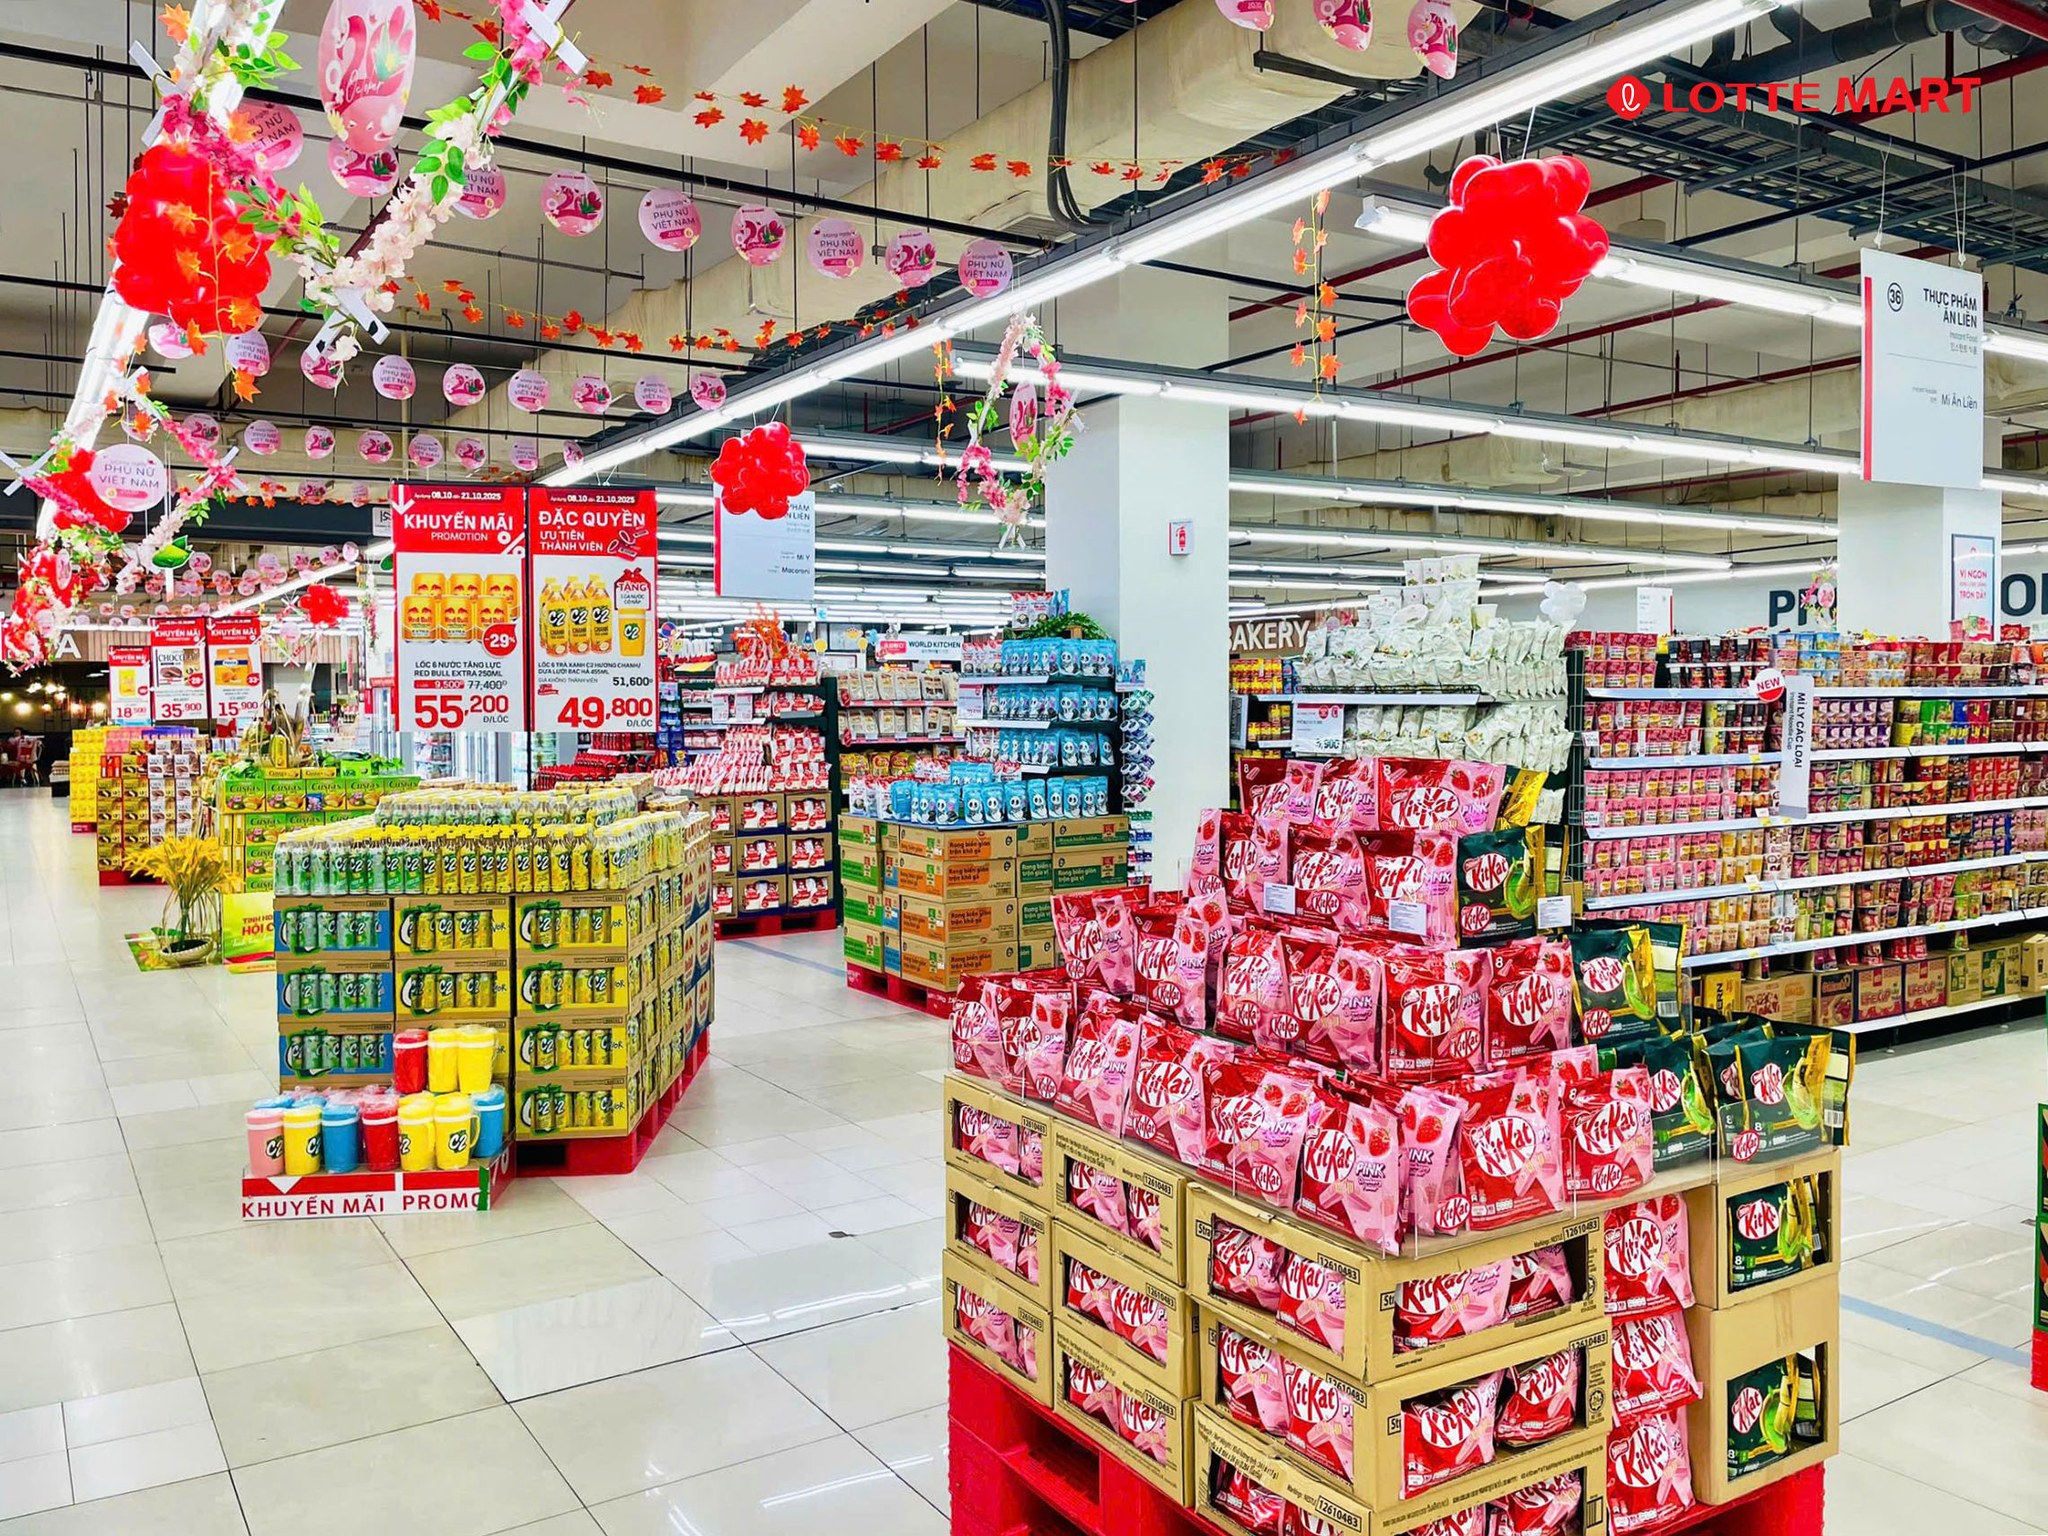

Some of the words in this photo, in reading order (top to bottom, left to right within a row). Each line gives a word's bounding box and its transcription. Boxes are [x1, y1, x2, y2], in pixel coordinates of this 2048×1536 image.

[674, 217, 695, 229] NAM
[839, 248, 859, 256] NAM
[841, 238, 855, 247] NỮ
[986, 270, 1008, 278] NAM
[991, 259, 1004, 269] NỮ
[1889, 289, 1901, 305] 36
[1923, 288, 1949, 308] THỰC
[130, 476, 159, 488] NAM
[404, 511, 476, 530] KHUYẾN
[480, 512, 513, 531] MÃI
[538, 508, 579, 529] ĐẶC
[583, 508, 646, 527] QUYỀN
[431, 532, 488, 541] PROMOTION
[540, 530, 557, 540] ƯU
[559, 529, 585, 540] TIÊN
[540, 540, 577, 551] THÀNH
[578, 540, 603, 551] VIÊN
[618, 581, 647, 593] TẶNG
[548, 610, 566, 626] C2
[571, 608, 588, 624] C2
[593, 606, 610, 623] C2
[624, 625, 640, 639] C2
[1229, 619, 1311, 651] AKERY
[933, 641, 961, 649] KITCHEN
[485, 661, 501, 669] LỰC
[1757, 677, 1781, 692] NEW
[415, 694, 509, 728] 55,200
[557, 696, 653, 729] 49,800
[627, 718, 653, 727] Đ/LỐC
[1399, 787, 1456, 826] KitKat
[443, 856, 457, 872] C2
[463, 857, 476, 872] C2
[515, 854, 530, 869] C2
[1297, 852, 1341, 889] KitKat
[1470, 854, 1508, 891] KitKat
[1314, 894, 1338, 913] KitKat
[439, 919, 453, 933] C2
[1463, 906, 1489, 931] KitKat
[1180, 957, 1204, 968] PINK
[1291, 974, 1338, 1020] KitKat
[1343, 996, 1372, 1010] PINK
[1508, 975, 1553, 1024] KitKat
[1411, 985, 1461, 1035] KitKat
[1273, 1015, 1299, 1037] KitKat
[1453, 1031, 1479, 1056] KitKat
[1141, 1062, 1191, 1106] KitKat
[1022, 1117, 1046, 1134] 12610483
[1135, 1117, 1156, 1139] KitKat
[1583, 1101, 1636, 1153] KitKat
[449, 1133, 468, 1151] C2
[1482, 1118, 1532, 1175] KitKat
[1305, 1130, 1353, 1182] KitKat
[1254, 1167, 1280, 1191] KitKat
[1356, 1161, 1386, 1179] PINK
[1596, 1167, 1622, 1190] KitKat
[1145, 1175, 1172, 1196] 12610483
[242, 1195, 335, 1218] KHUYẾN
[343, 1194, 385, 1213] MÃI
[1437, 1199, 1469, 1228] KitKat
[1565, 1223, 1597, 1238] 12610483
[1617, 1218, 1660, 1273] KitKat
[1147, 1285, 1174, 1306] 12610483
[1402, 1270, 1468, 1313] KitKat
[1146, 1392, 1174, 1417] 12610483
[1290, 1369, 1335, 1420] KitKat
[1318, 1500, 1359, 1527] 12610483
